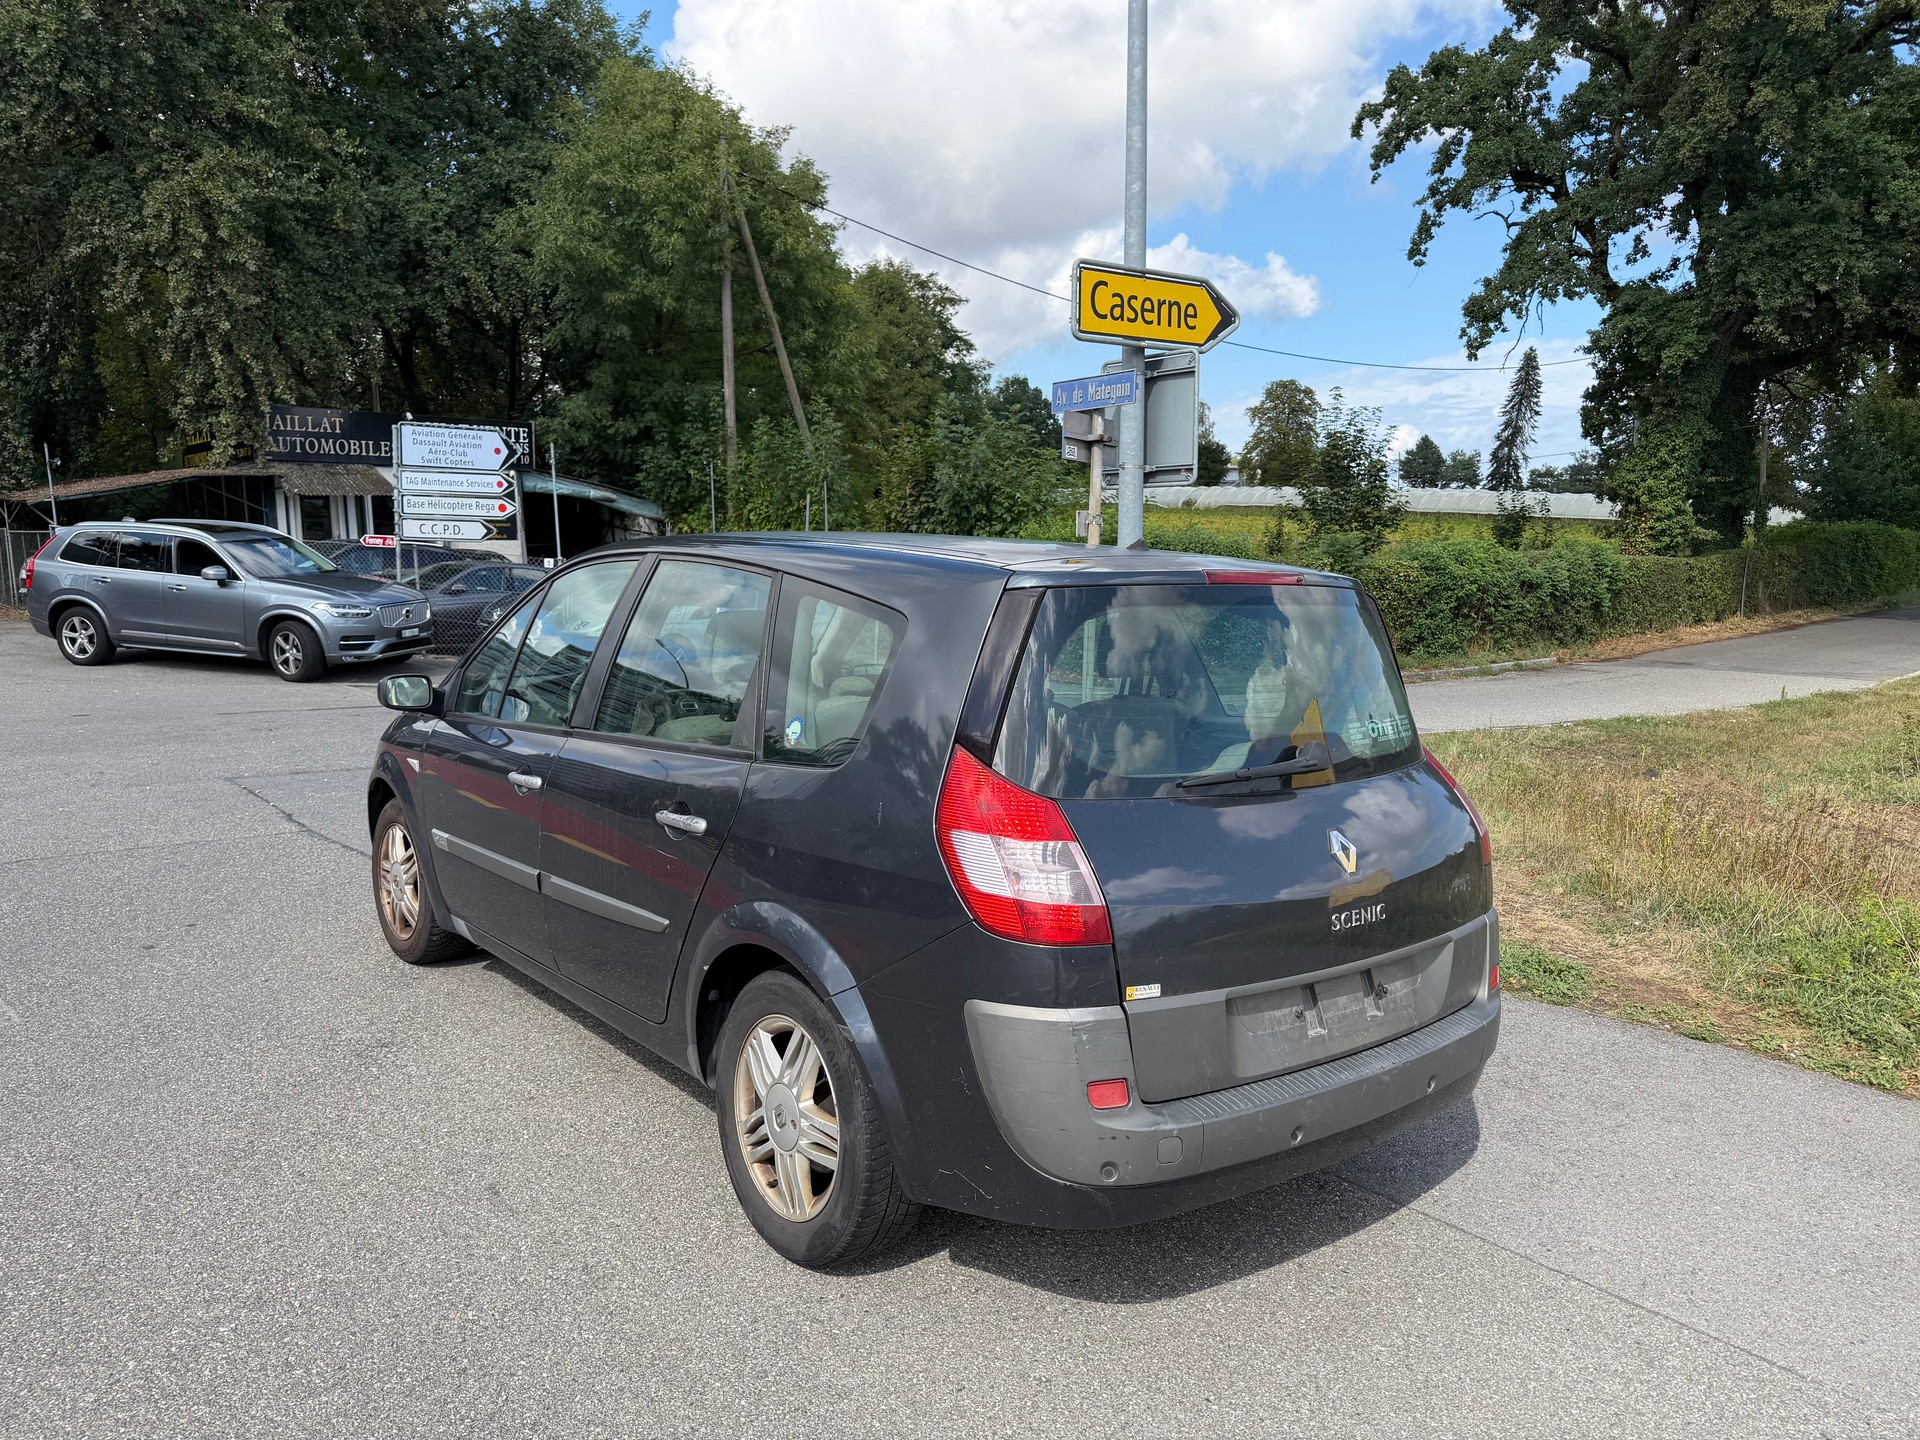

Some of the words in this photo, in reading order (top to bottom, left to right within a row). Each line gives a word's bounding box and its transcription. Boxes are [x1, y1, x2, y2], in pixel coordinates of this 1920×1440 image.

[1090, 280, 1198, 331] Caserne
[1056, 388, 1070, 407] Av.
[1073, 385, 1083, 404] de
[1088, 380, 1131, 404] Mategnin
[411, 429, 446, 438] Aviation
[448, 430, 483, 440] Générale
[412, 438, 447, 447] Dassault
[449, 440, 482, 449] Aviation
[428, 448, 468, 457] Aéro-Club
[421, 456, 442, 465] Swift
[445, 458, 475, 467] Copters
[405, 477, 419, 486] TAG
[420, 477, 464, 487] Maintenance
[466, 478, 494, 488] Services
[407, 499, 425, 508] Base
[428, 500, 473, 514] Hélicoptère
[476, 501, 495, 513] Rega
[419, 524, 464, 536] C.C.P.D.
[1331, 903, 1386, 931] SCENIC
